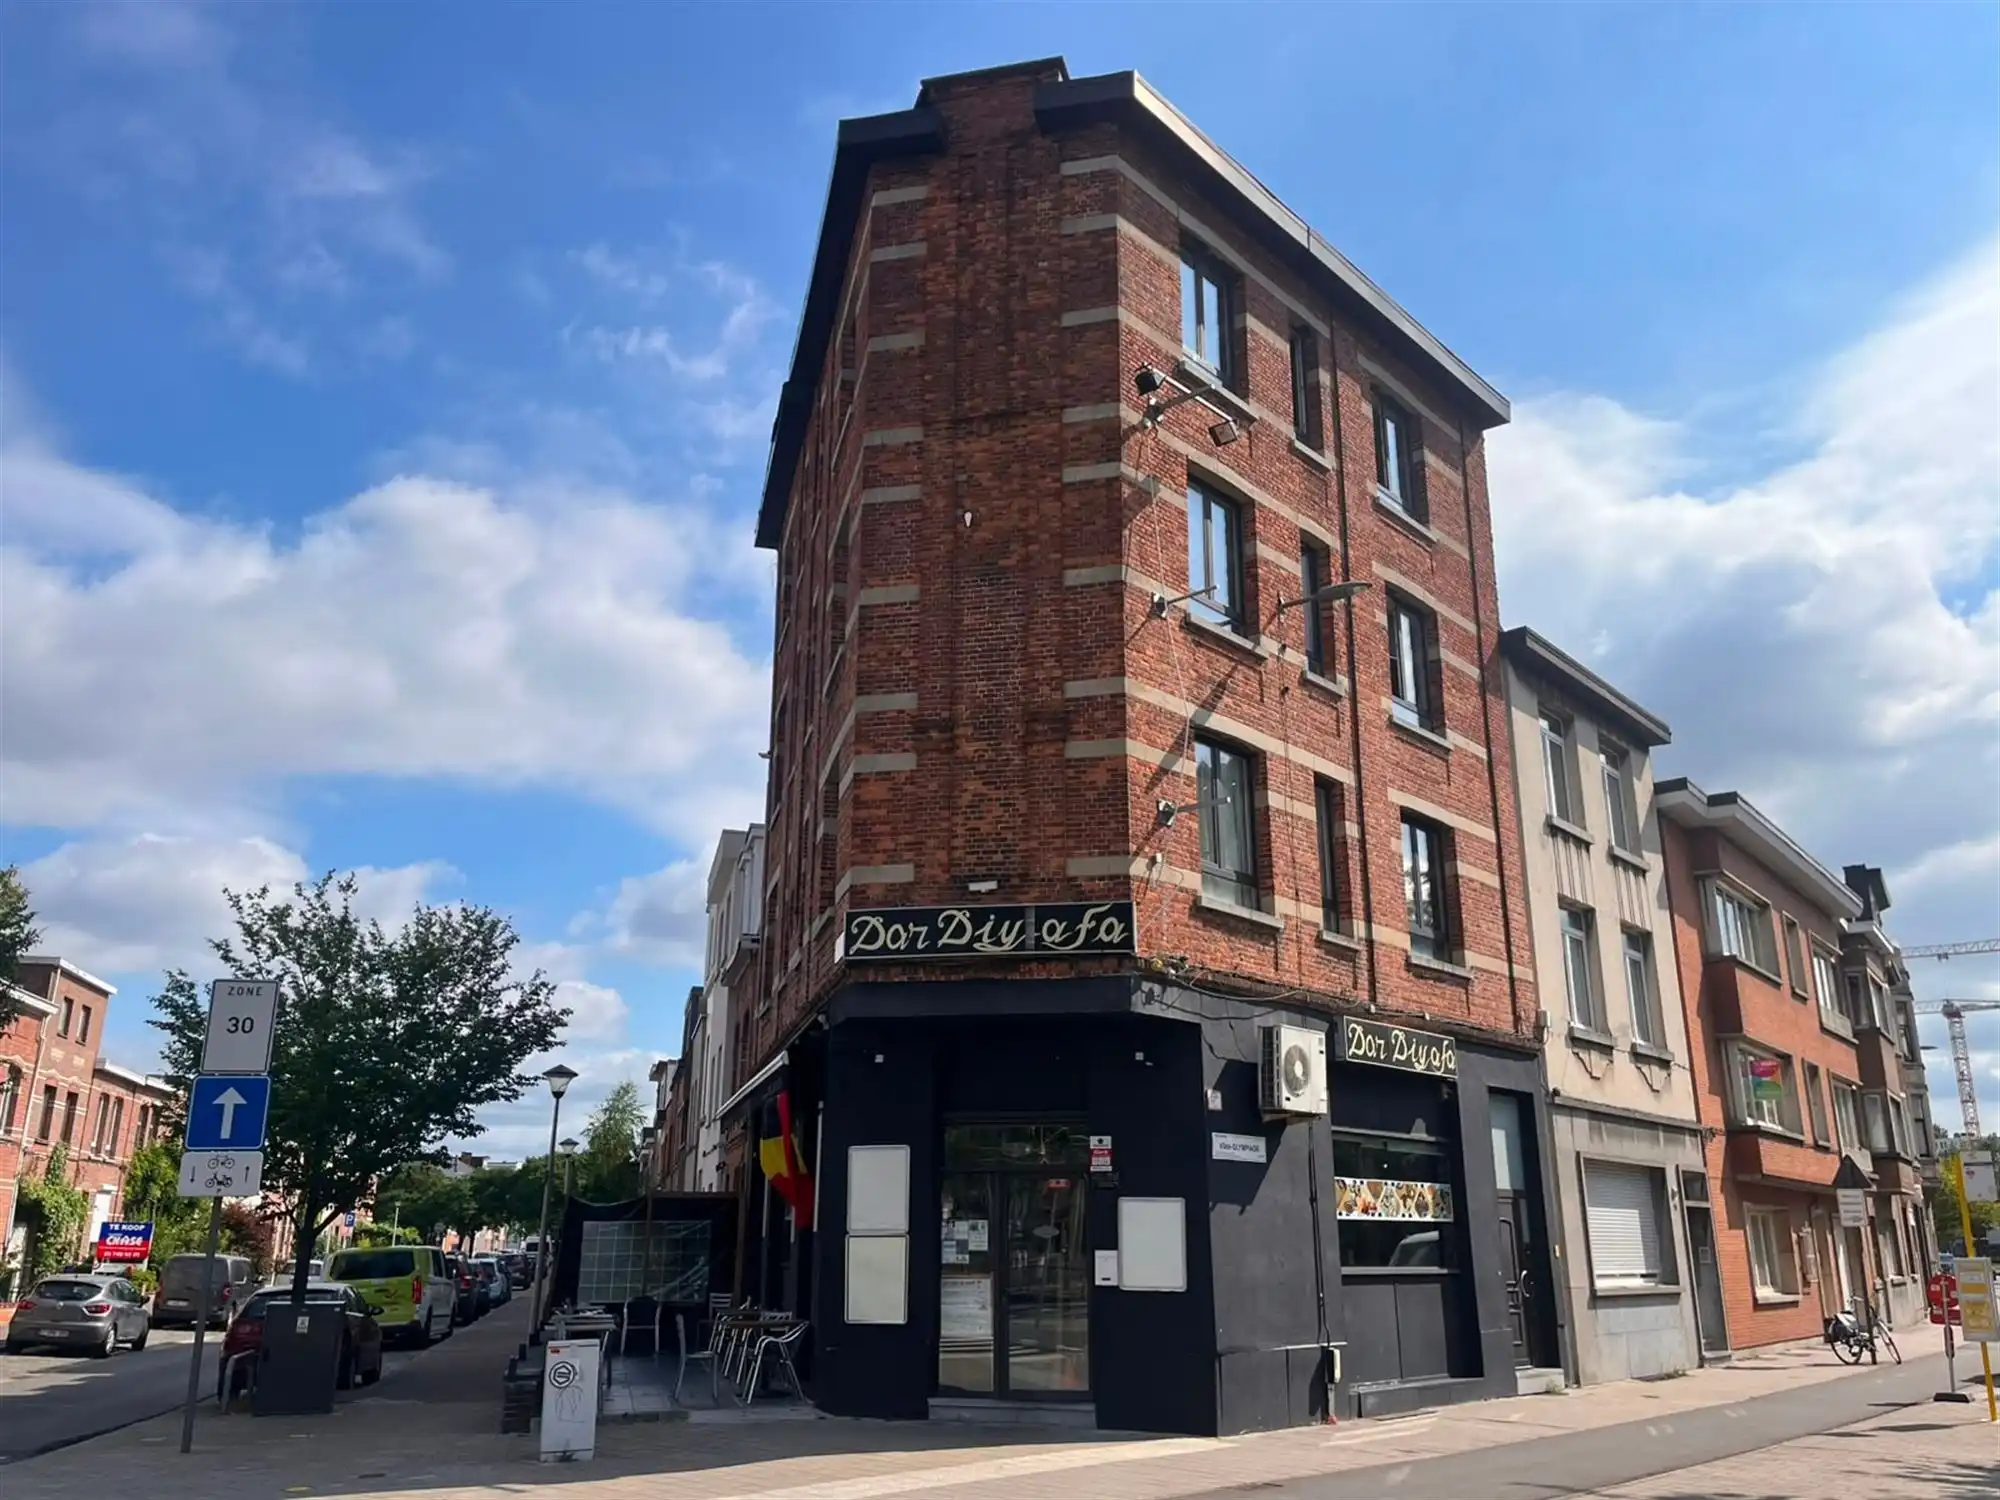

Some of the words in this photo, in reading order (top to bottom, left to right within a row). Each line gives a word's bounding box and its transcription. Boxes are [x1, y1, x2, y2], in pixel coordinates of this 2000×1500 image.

[227, 985, 264, 996] ZONE
[226, 1016, 254, 1034] 30
[109, 1223, 120, 1231] TE
